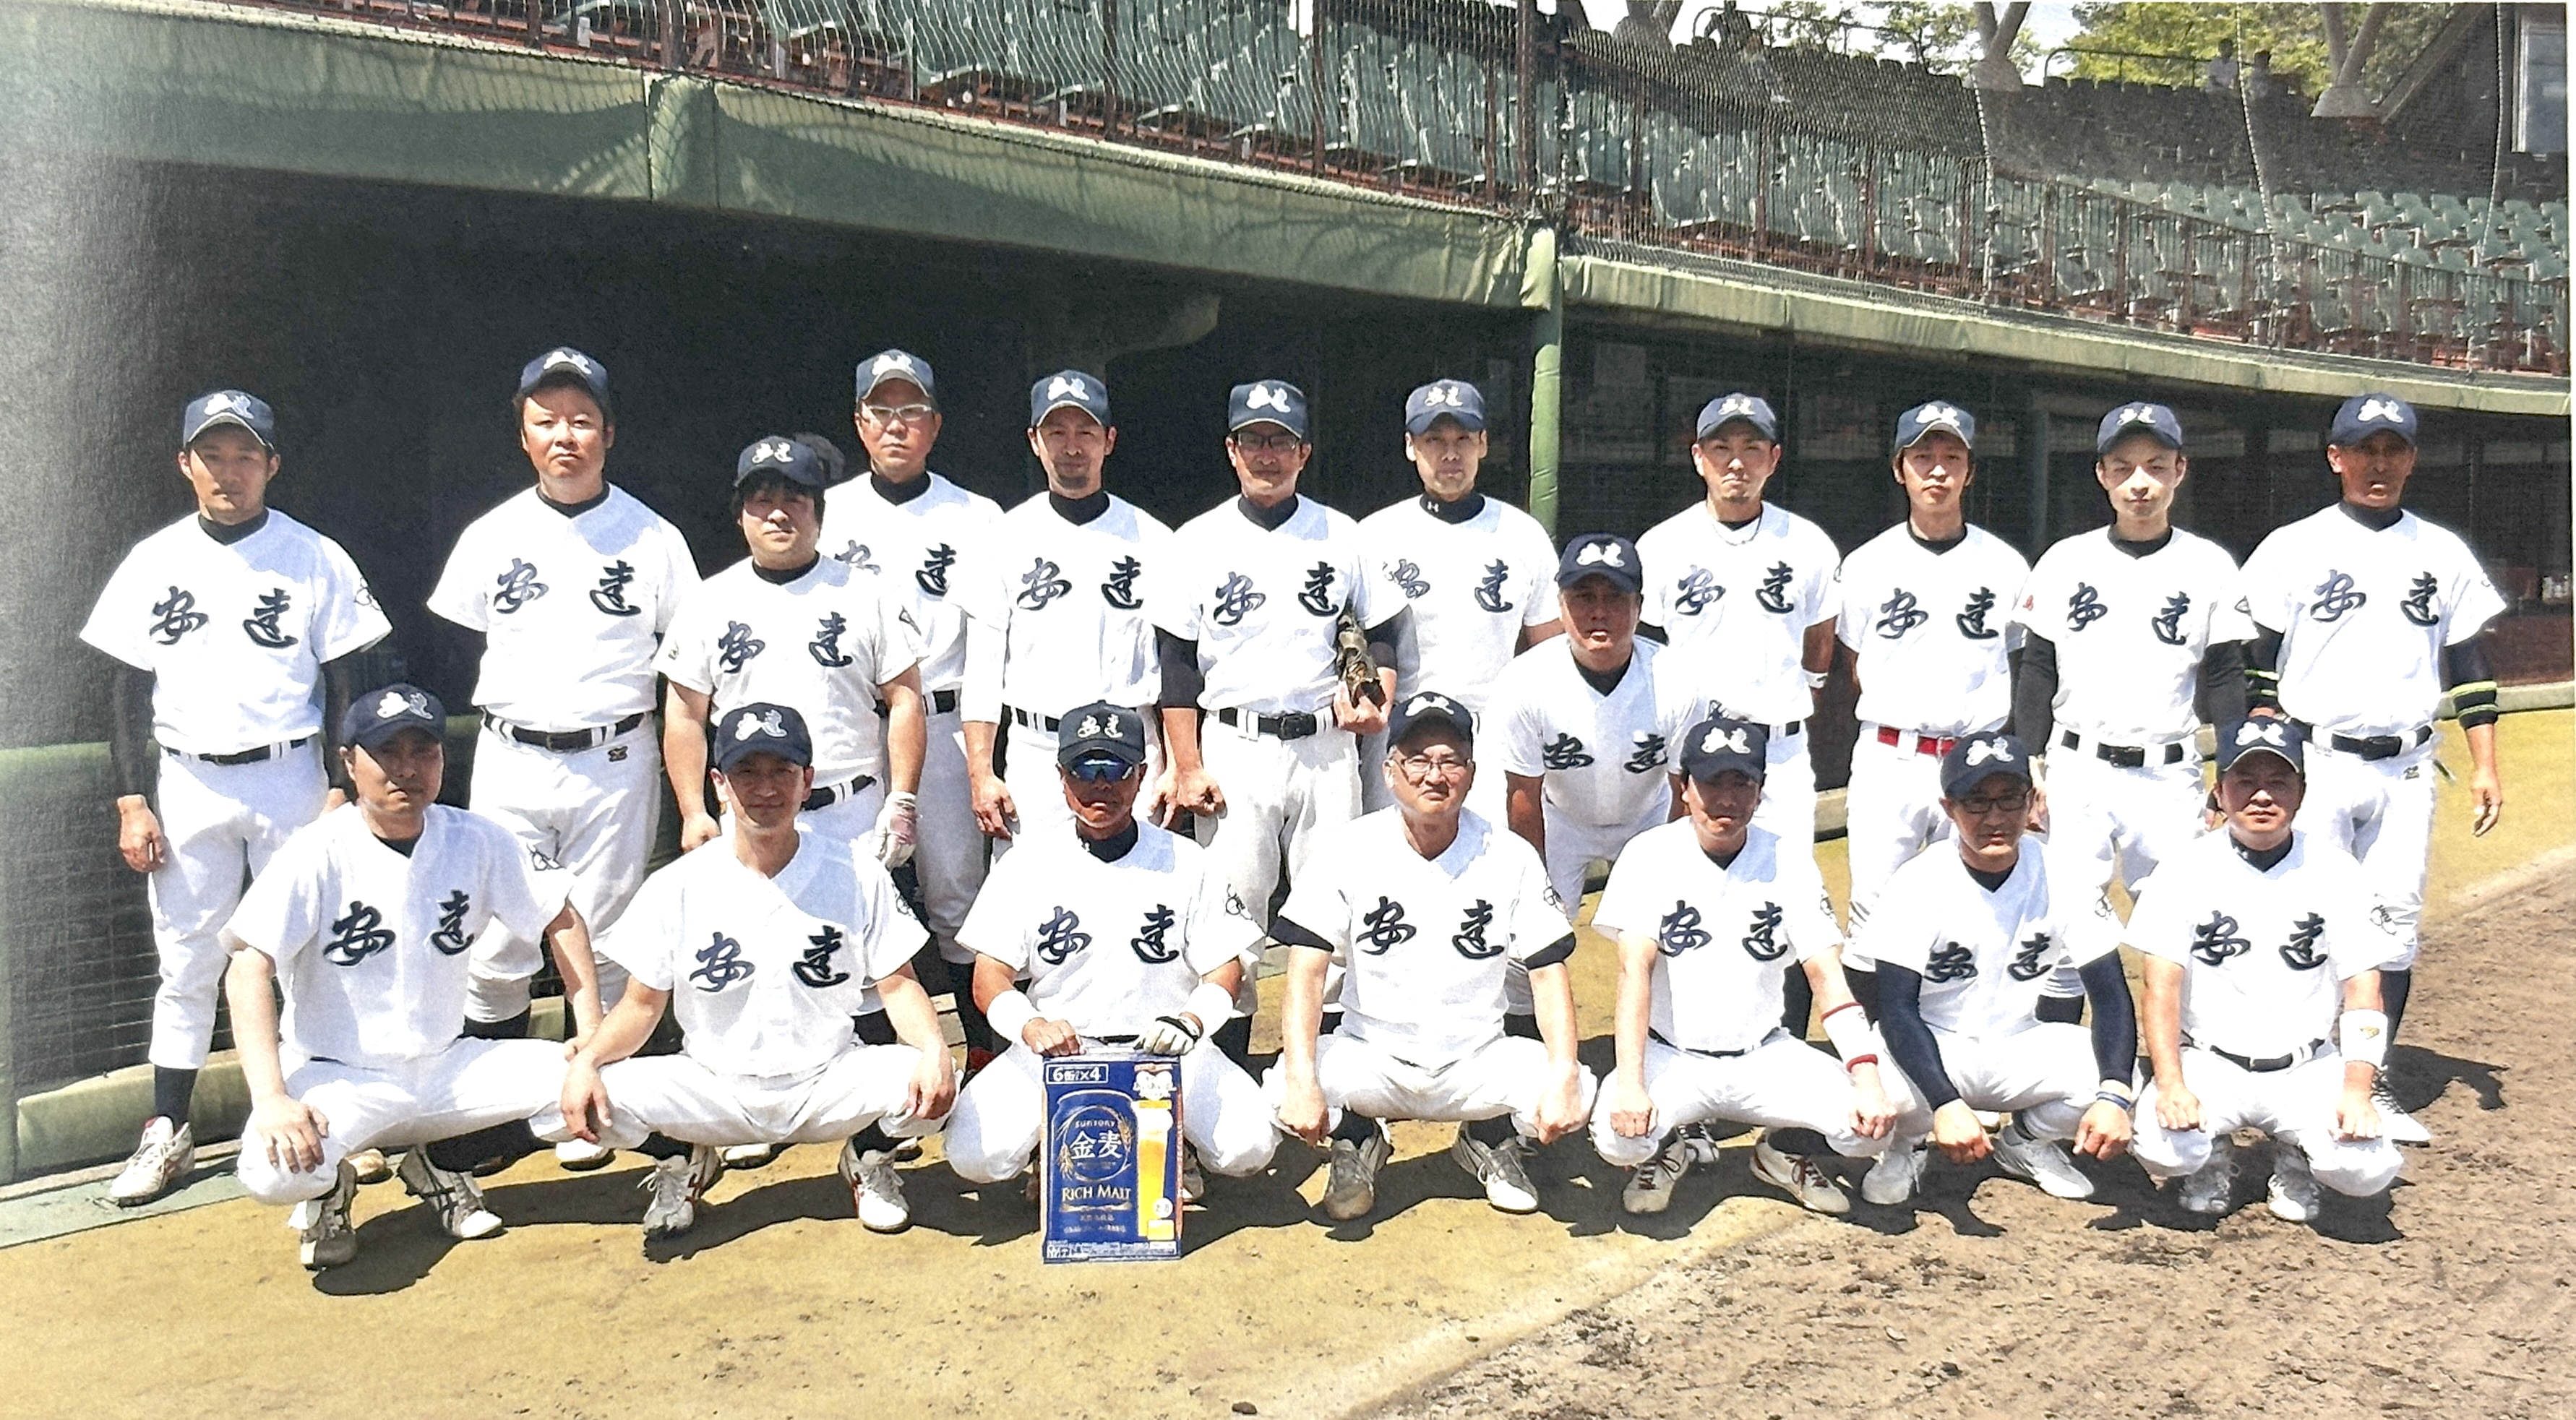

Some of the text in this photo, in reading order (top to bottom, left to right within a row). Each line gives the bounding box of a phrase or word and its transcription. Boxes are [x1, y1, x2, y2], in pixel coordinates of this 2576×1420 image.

[1070, 1130, 1122, 1159] 金麦
[1062, 1184, 1132, 1201] RICH MALT
